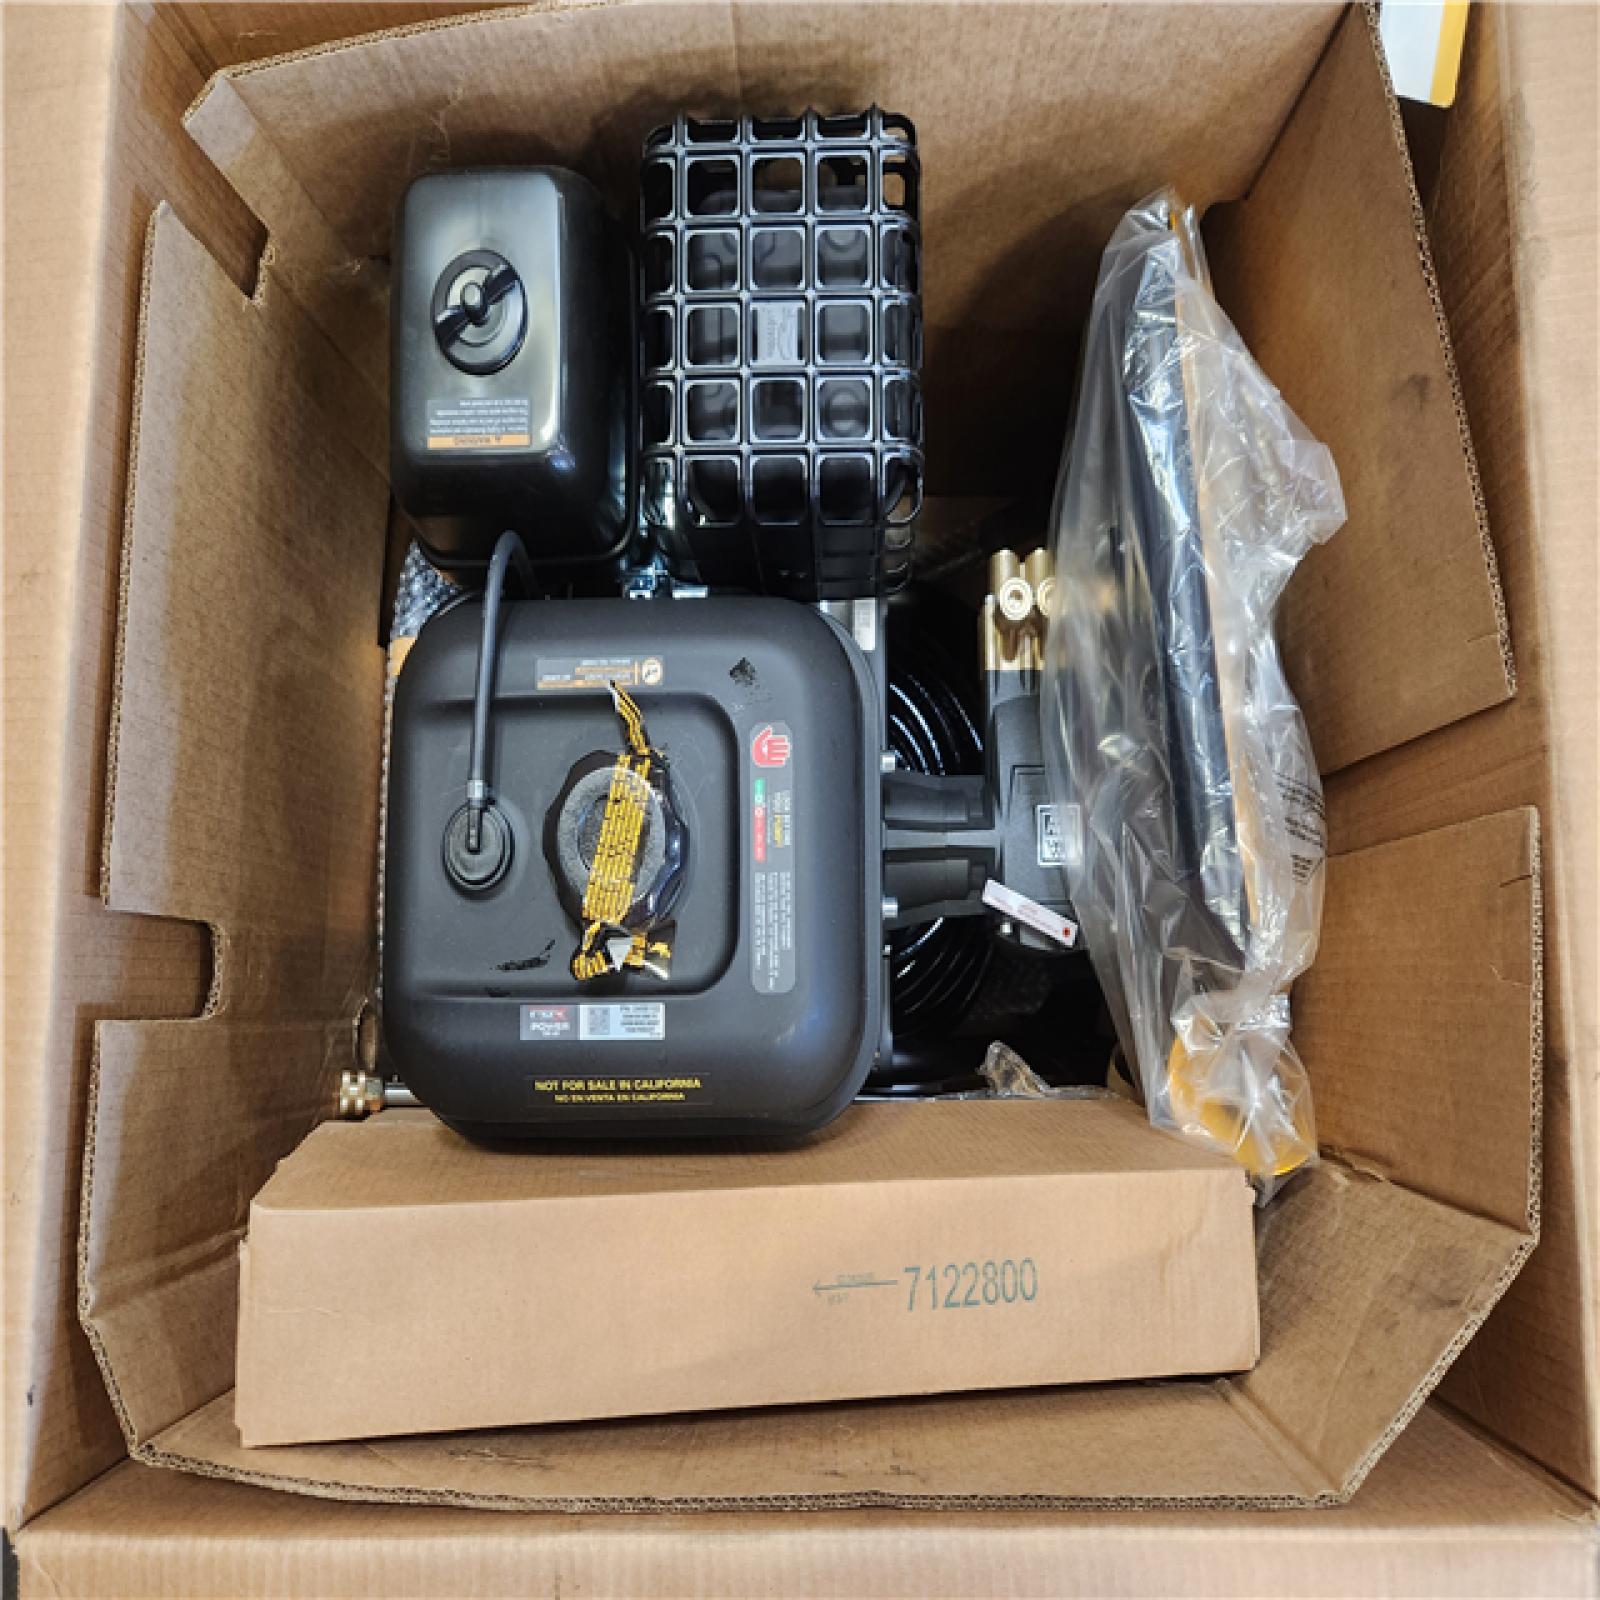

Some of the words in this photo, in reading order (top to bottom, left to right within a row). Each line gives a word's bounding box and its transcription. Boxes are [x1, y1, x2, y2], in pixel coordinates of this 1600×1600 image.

[534, 1079, 558, 1091] NOT
[562, 1079, 585, 1091] FOR
[587, 1079, 616, 1091] SALE
[619, 1079, 631, 1091] IN
[634, 1077, 701, 1091] CALIFORNIA
[632, 1092, 686, 1102] CALIFORNIA
[904, 1257, 1038, 1312] 7122800
